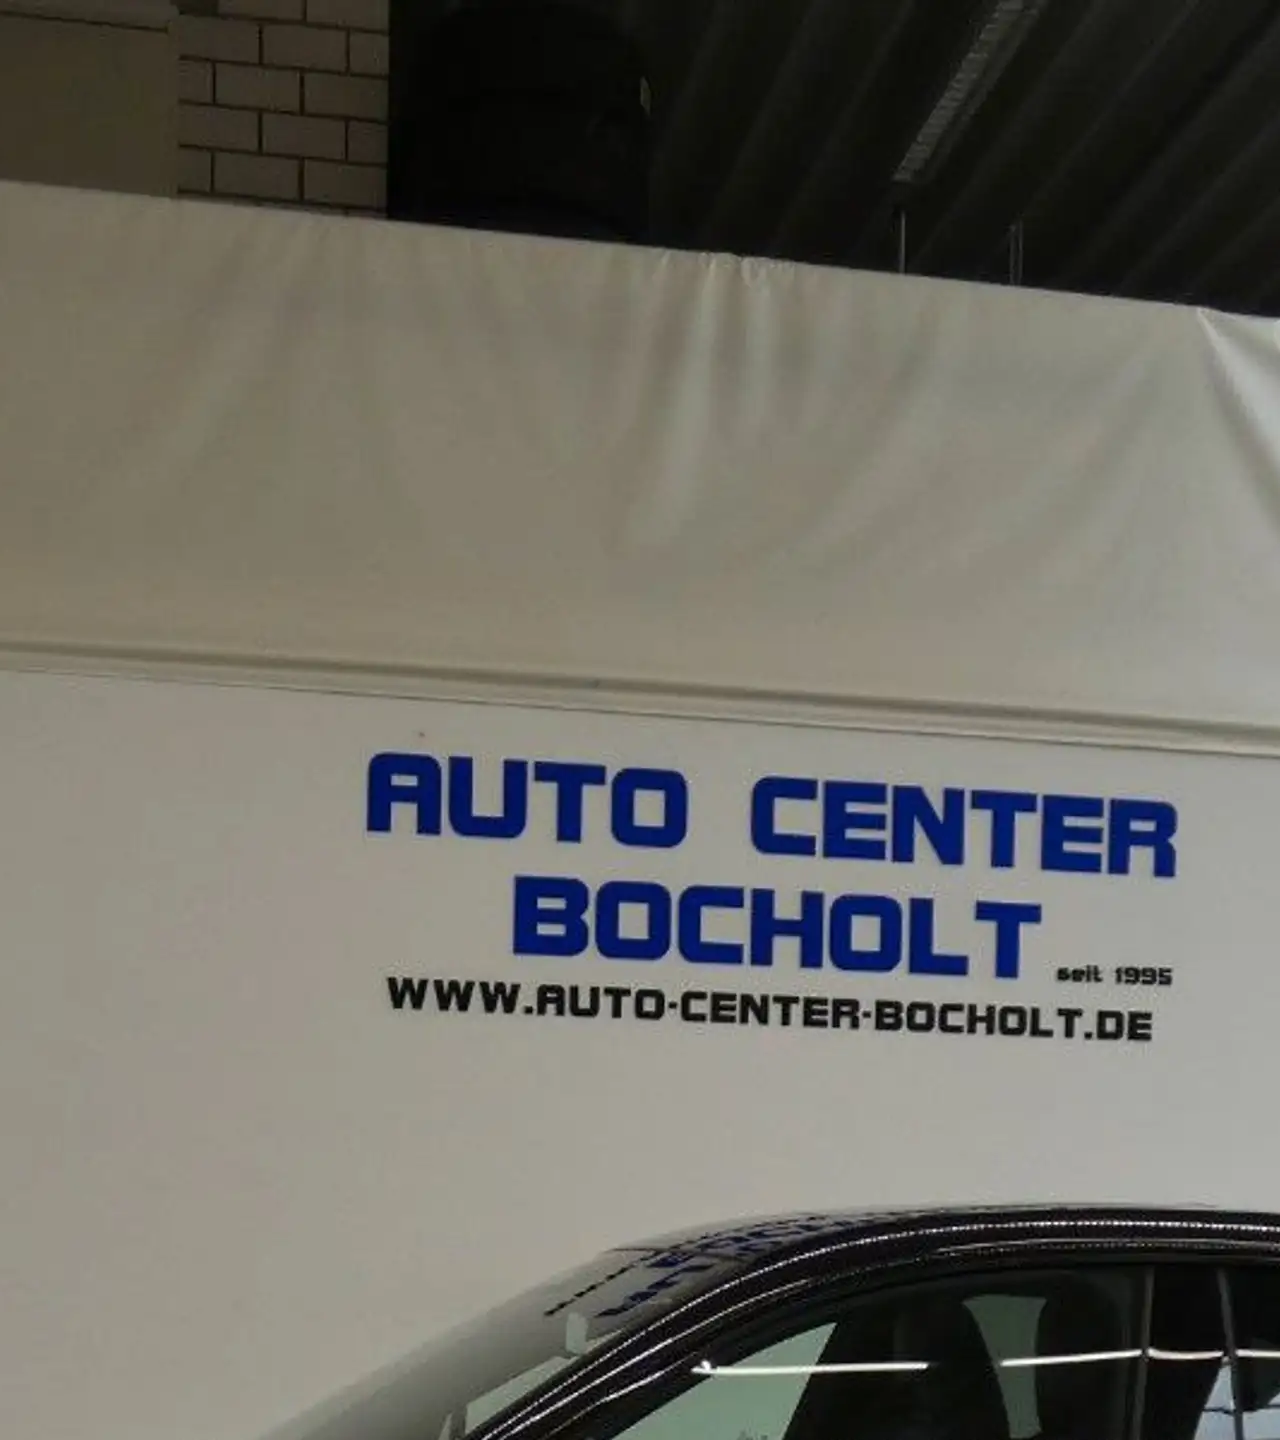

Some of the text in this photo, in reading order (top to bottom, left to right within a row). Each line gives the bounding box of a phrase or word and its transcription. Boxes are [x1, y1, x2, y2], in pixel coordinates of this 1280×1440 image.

[366, 753, 1178, 878] AUTO CENTER
[513, 875, 1173, 986] BOCHOLT seit 1995
[385, 976, 1153, 1042] WWW.AUTO-CENTER-BOCHOLT.DE
